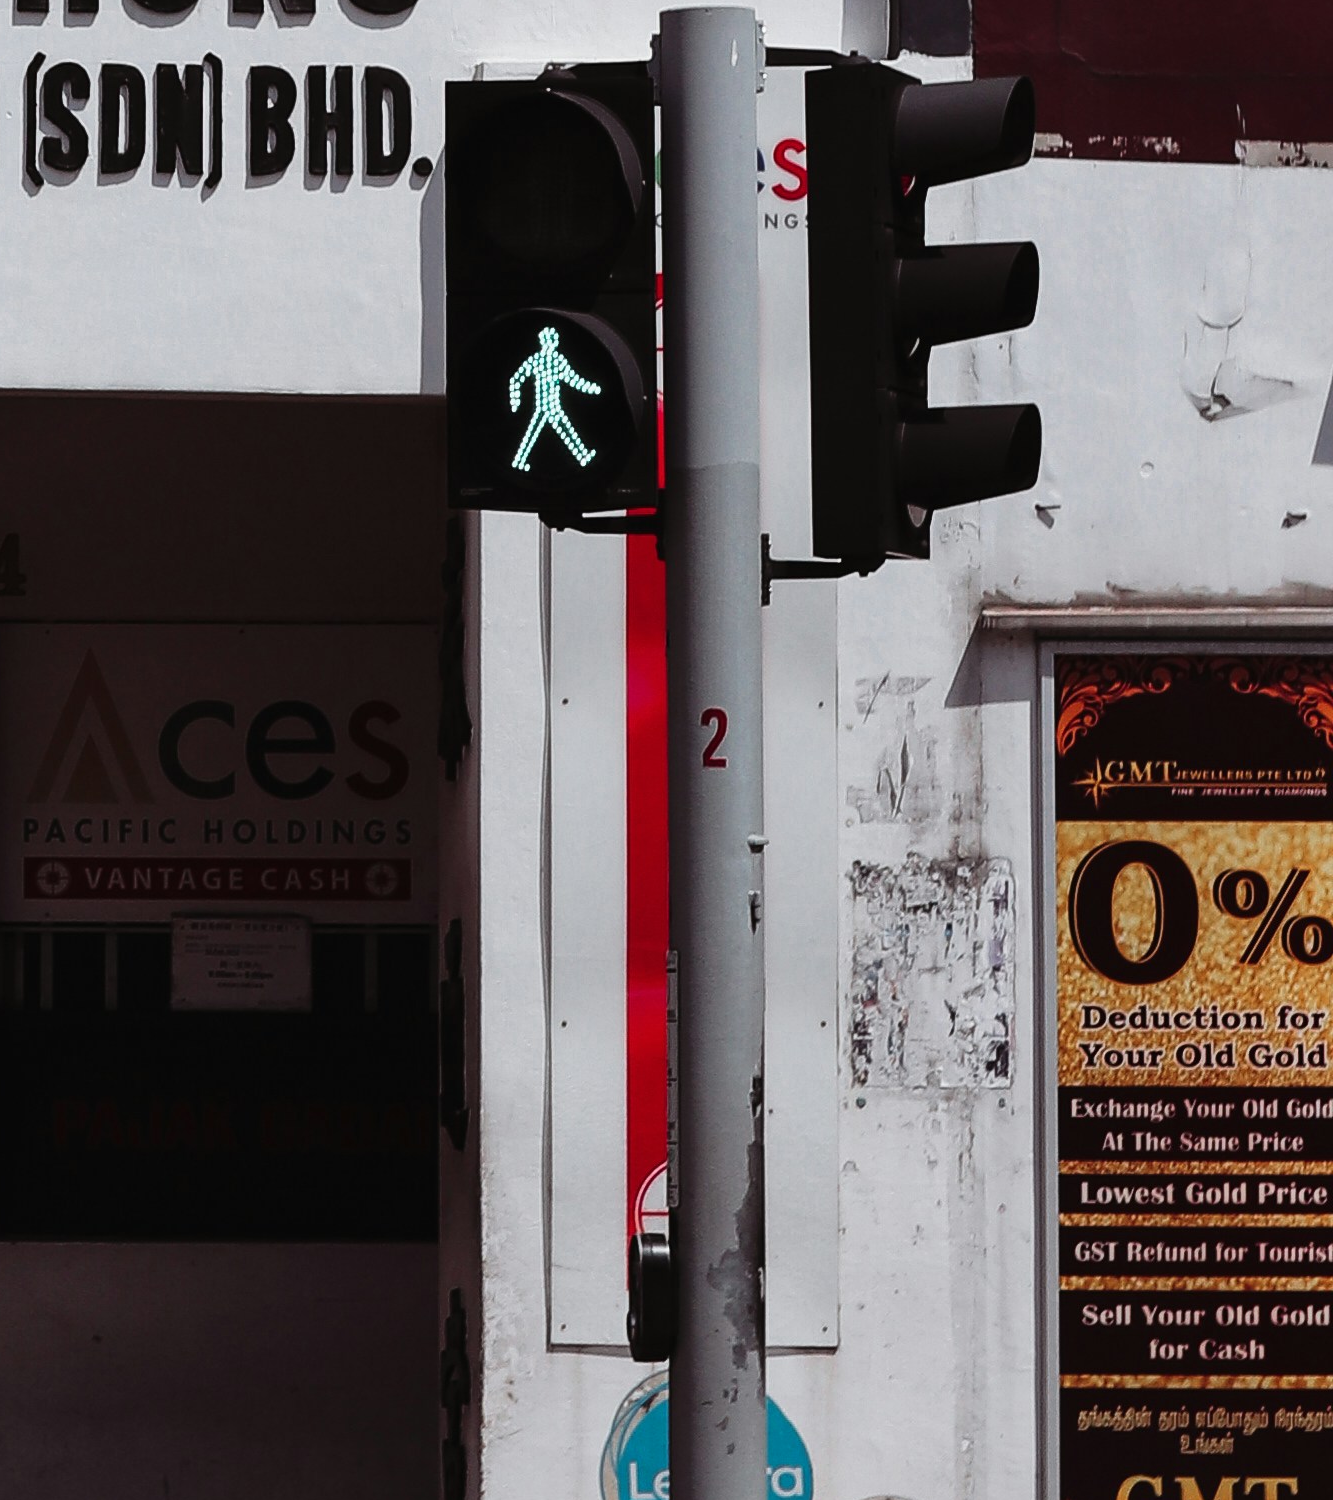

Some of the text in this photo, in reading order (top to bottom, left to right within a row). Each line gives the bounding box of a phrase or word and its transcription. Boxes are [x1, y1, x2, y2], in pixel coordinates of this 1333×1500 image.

[250, 66, 433, 178] BHD.
[25, 646, 410, 801] Aces
[700, 708, 729, 769] 2
[1104, 760, 1312, 782] GMT JEWELLERS PTE LTD
[1171, 787, 1195, 797] FINE
[1201, 787, 1261, 797] JEWELLERY
[1274, 787, 1328, 797] DIAMONDS
[23, 817, 412, 846] PACIFIC HOLDINGS
[84, 867, 351, 893] VANTAGE CASH
[1068, 840, 1333, 986] 0%
[1080, 1004, 1327, 1032] Deduction for
[1080, 1042, 1329, 1071] Your Old Gold
[1070, 1098, 1333, 1123] Exchange Your Old Gold
[1101, 1131, 1304, 1152] At The Same Price
[1079, 1181, 1328, 1205] Lowest Gold Price
[1074, 1241, 1120, 1263] GST
[1126, 1241, 1207, 1263] Refund
[1215, 1241, 1249, 1263] for
[1081, 1304, 1331, 1327] Sell Your Old Gold
[1149, 1338, 1266, 1361] for Cash
